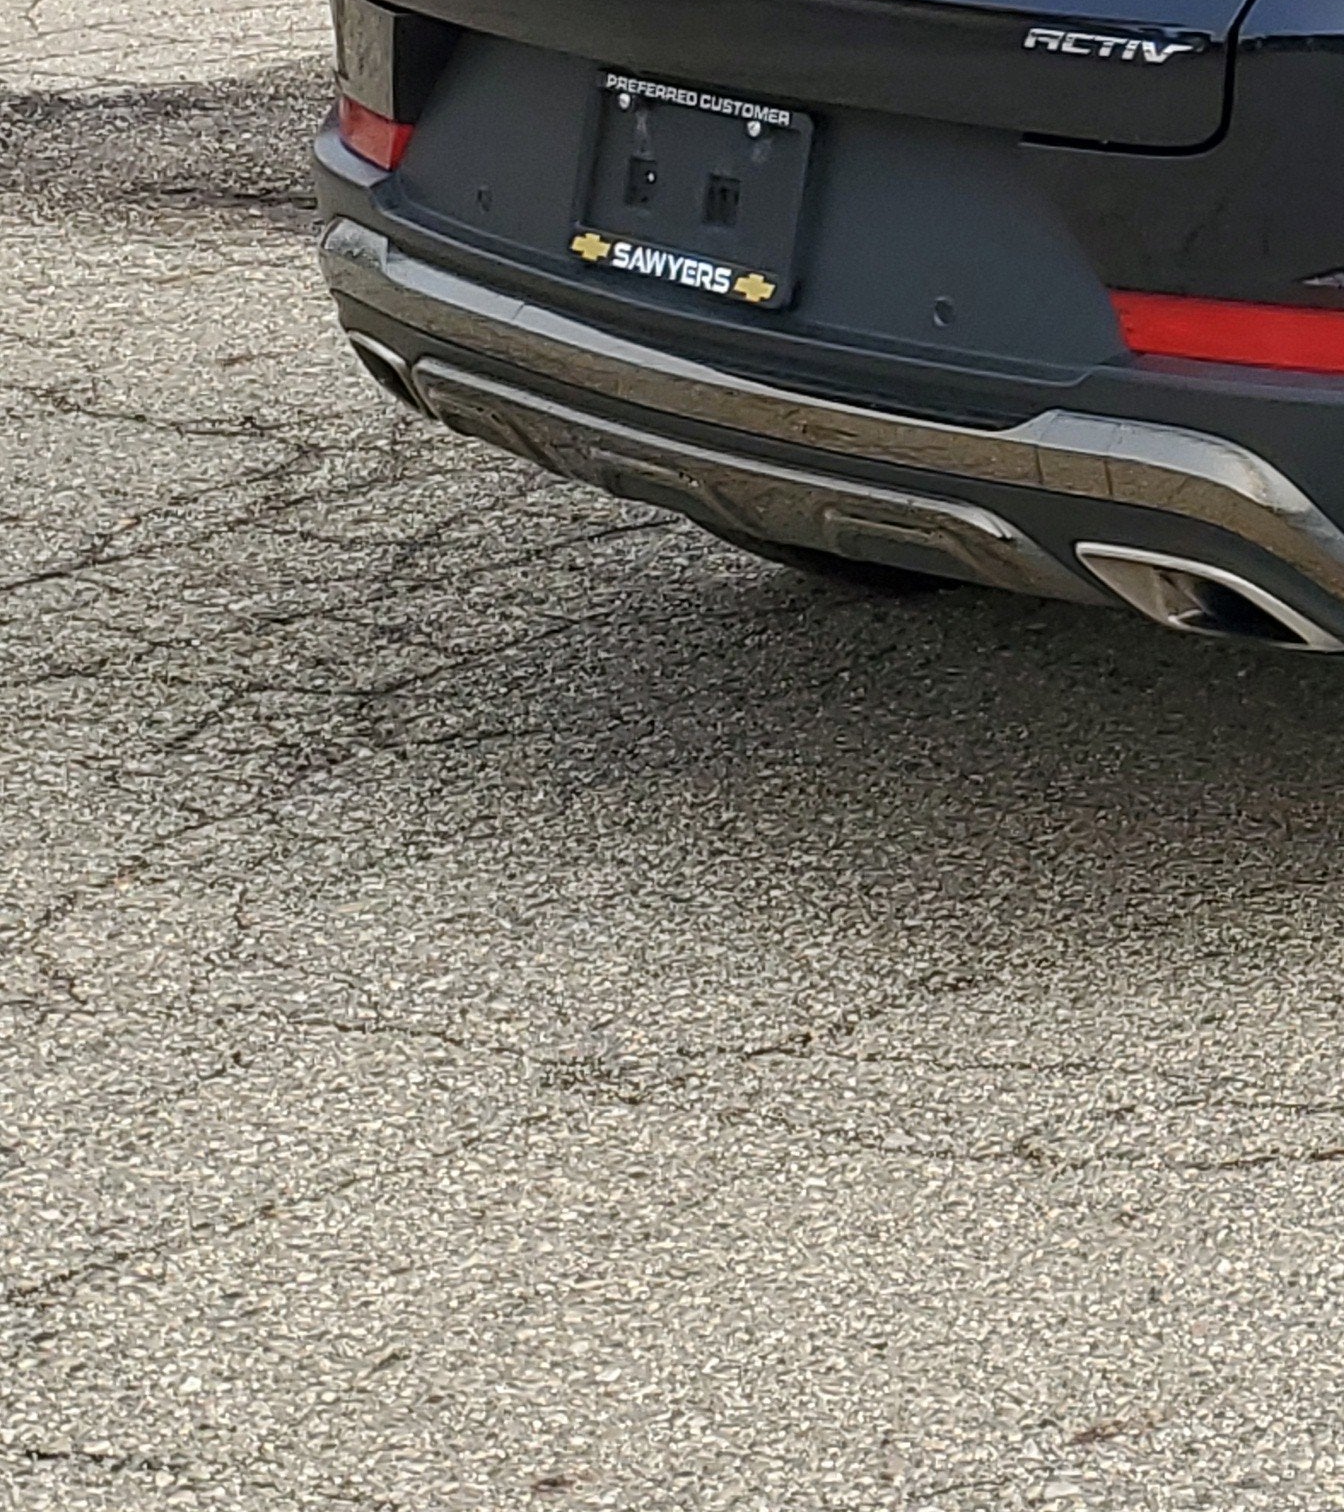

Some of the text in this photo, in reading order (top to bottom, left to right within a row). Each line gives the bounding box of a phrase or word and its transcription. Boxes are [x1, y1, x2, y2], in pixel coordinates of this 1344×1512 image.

[1023, 27, 1194, 64] ACTIV
[606, 73, 790, 127] PREFERRED CUSTOMER
[612, 241, 732, 295] SAWYERS
